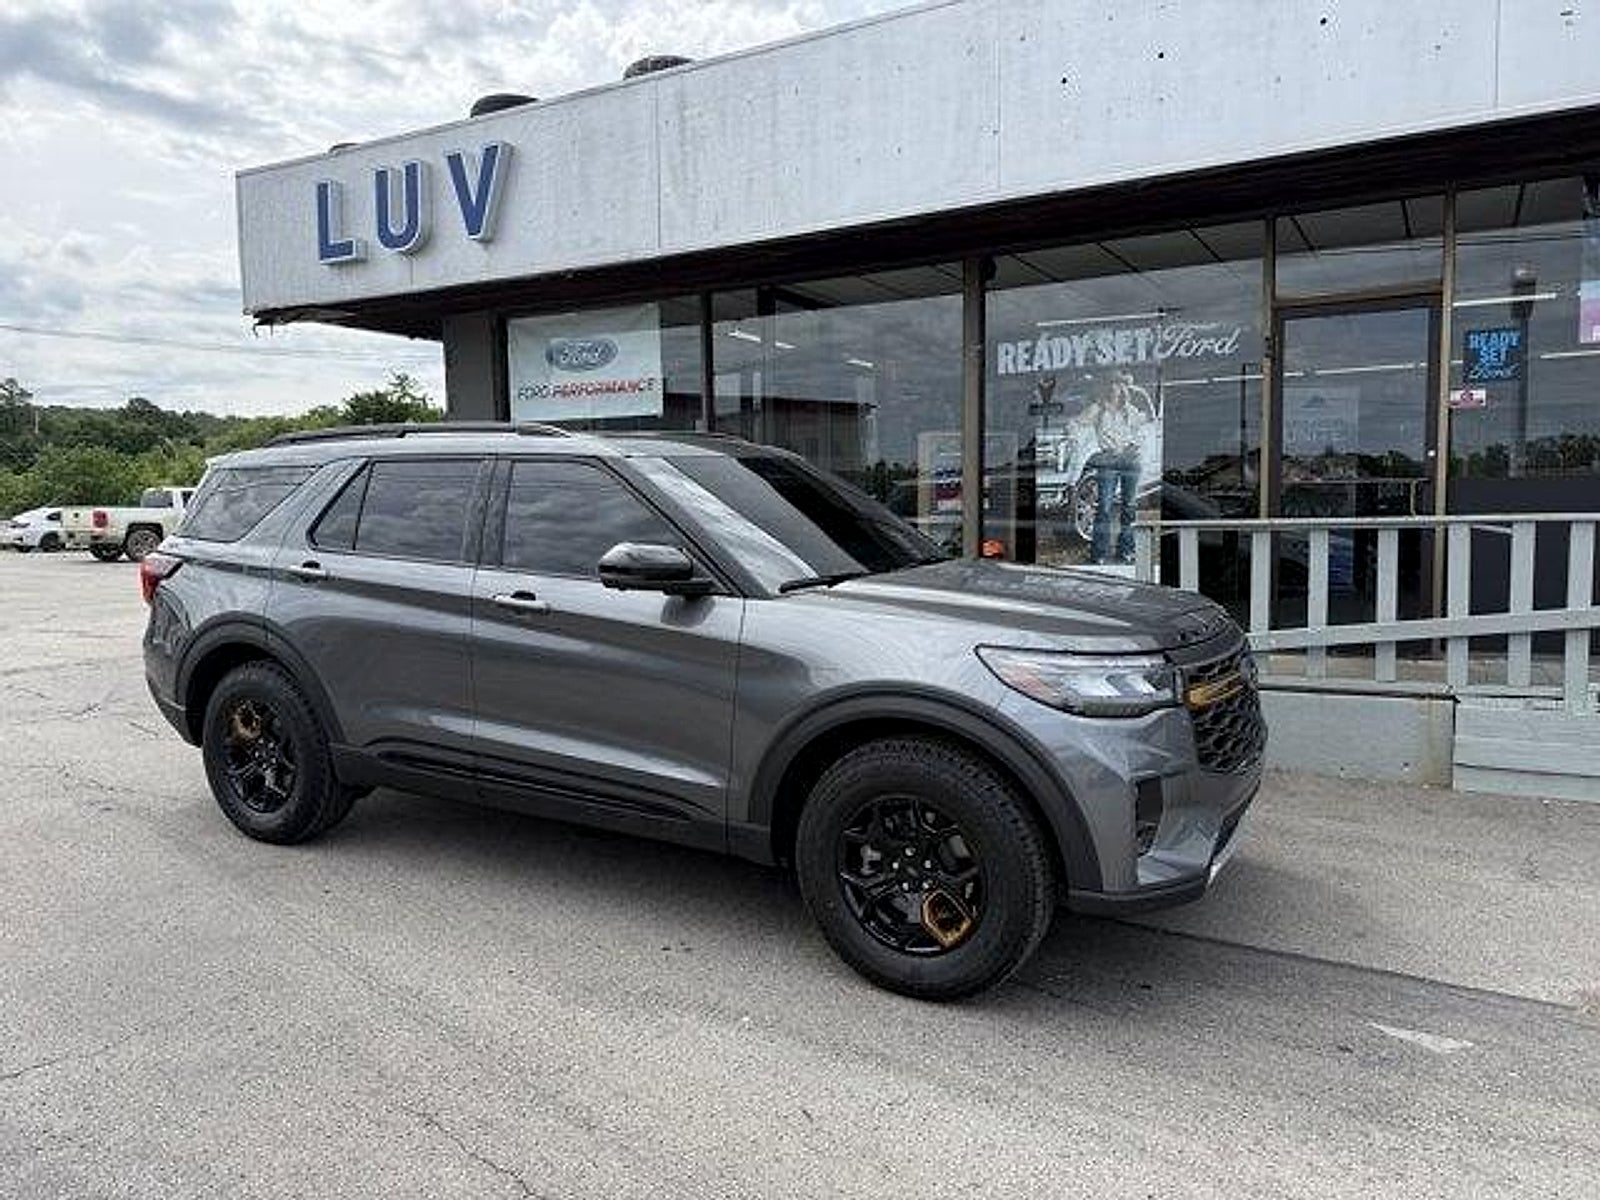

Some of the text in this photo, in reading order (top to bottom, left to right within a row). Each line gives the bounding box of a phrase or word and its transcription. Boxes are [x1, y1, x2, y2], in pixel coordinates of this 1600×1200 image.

[316, 141, 512, 264] LUV
[997, 322, 1242, 375] READY SET Ford
[1468, 331, 1521, 350] READY
[1479, 347, 1508, 364] SET
[517, 376, 656, 400] FORD PERFORMANCE
